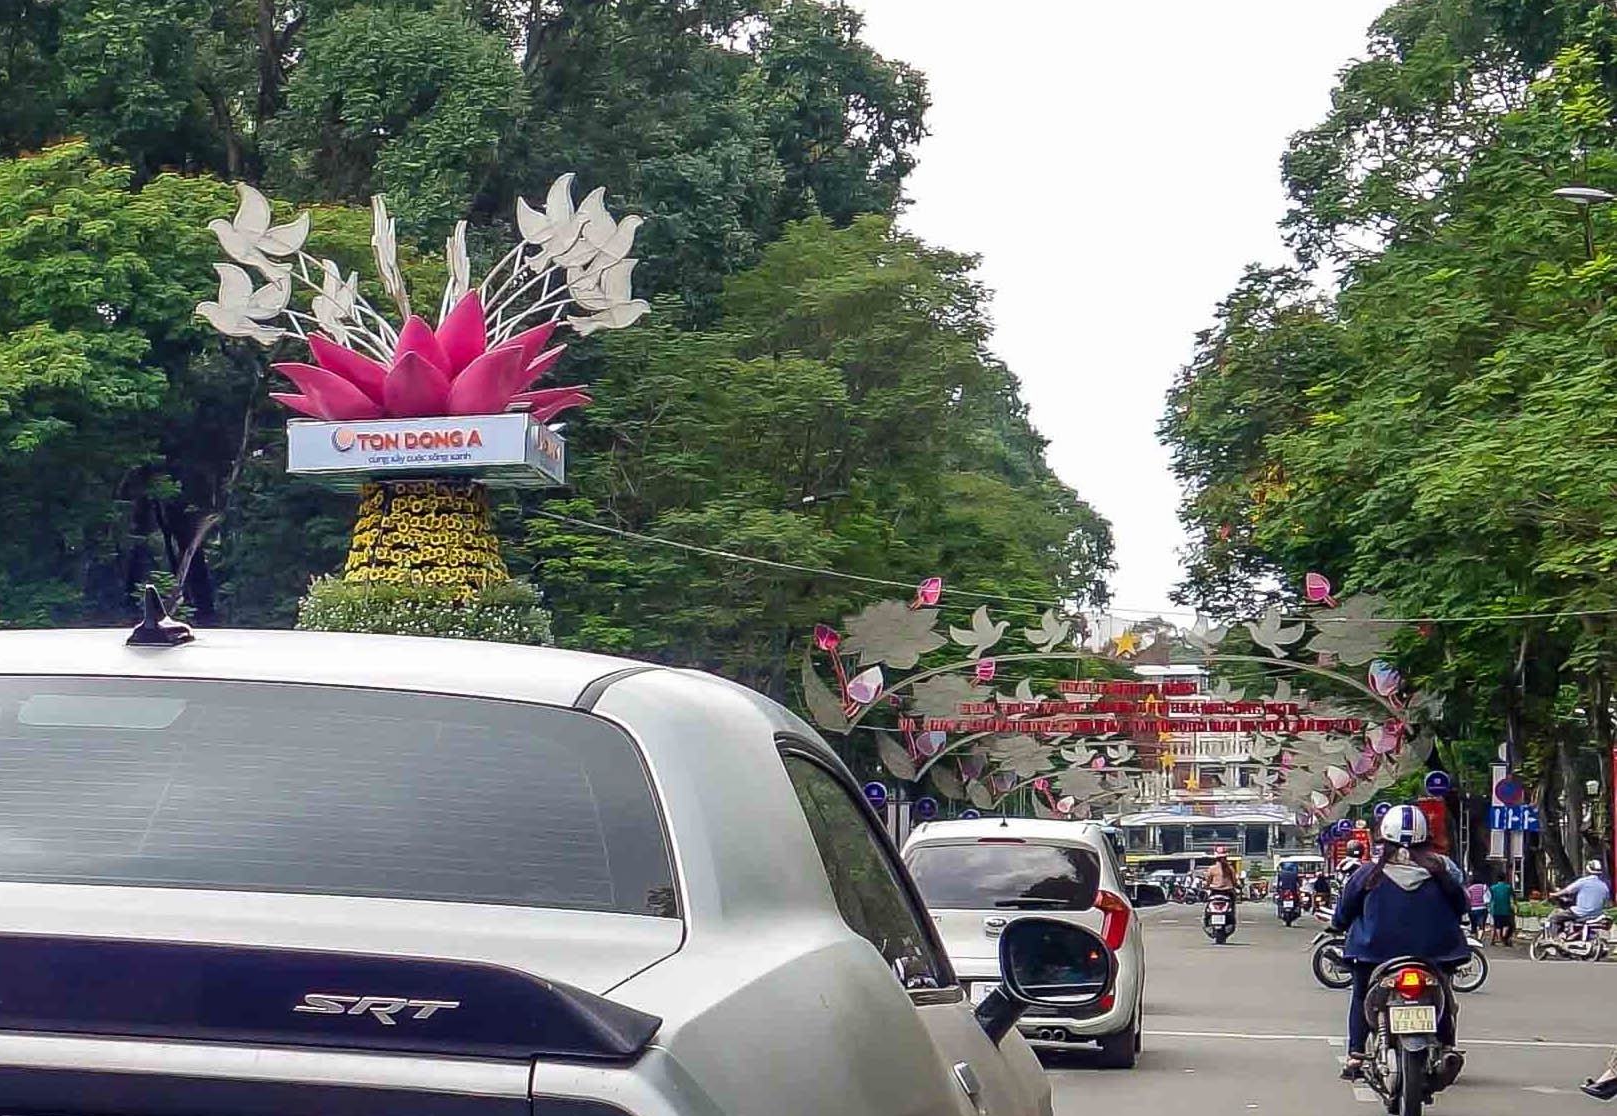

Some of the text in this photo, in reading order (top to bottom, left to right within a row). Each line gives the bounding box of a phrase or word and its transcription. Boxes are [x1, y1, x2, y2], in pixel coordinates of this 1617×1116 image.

[356, 429, 482, 451] TON DONG A
[293, 993, 461, 1026] SRT
